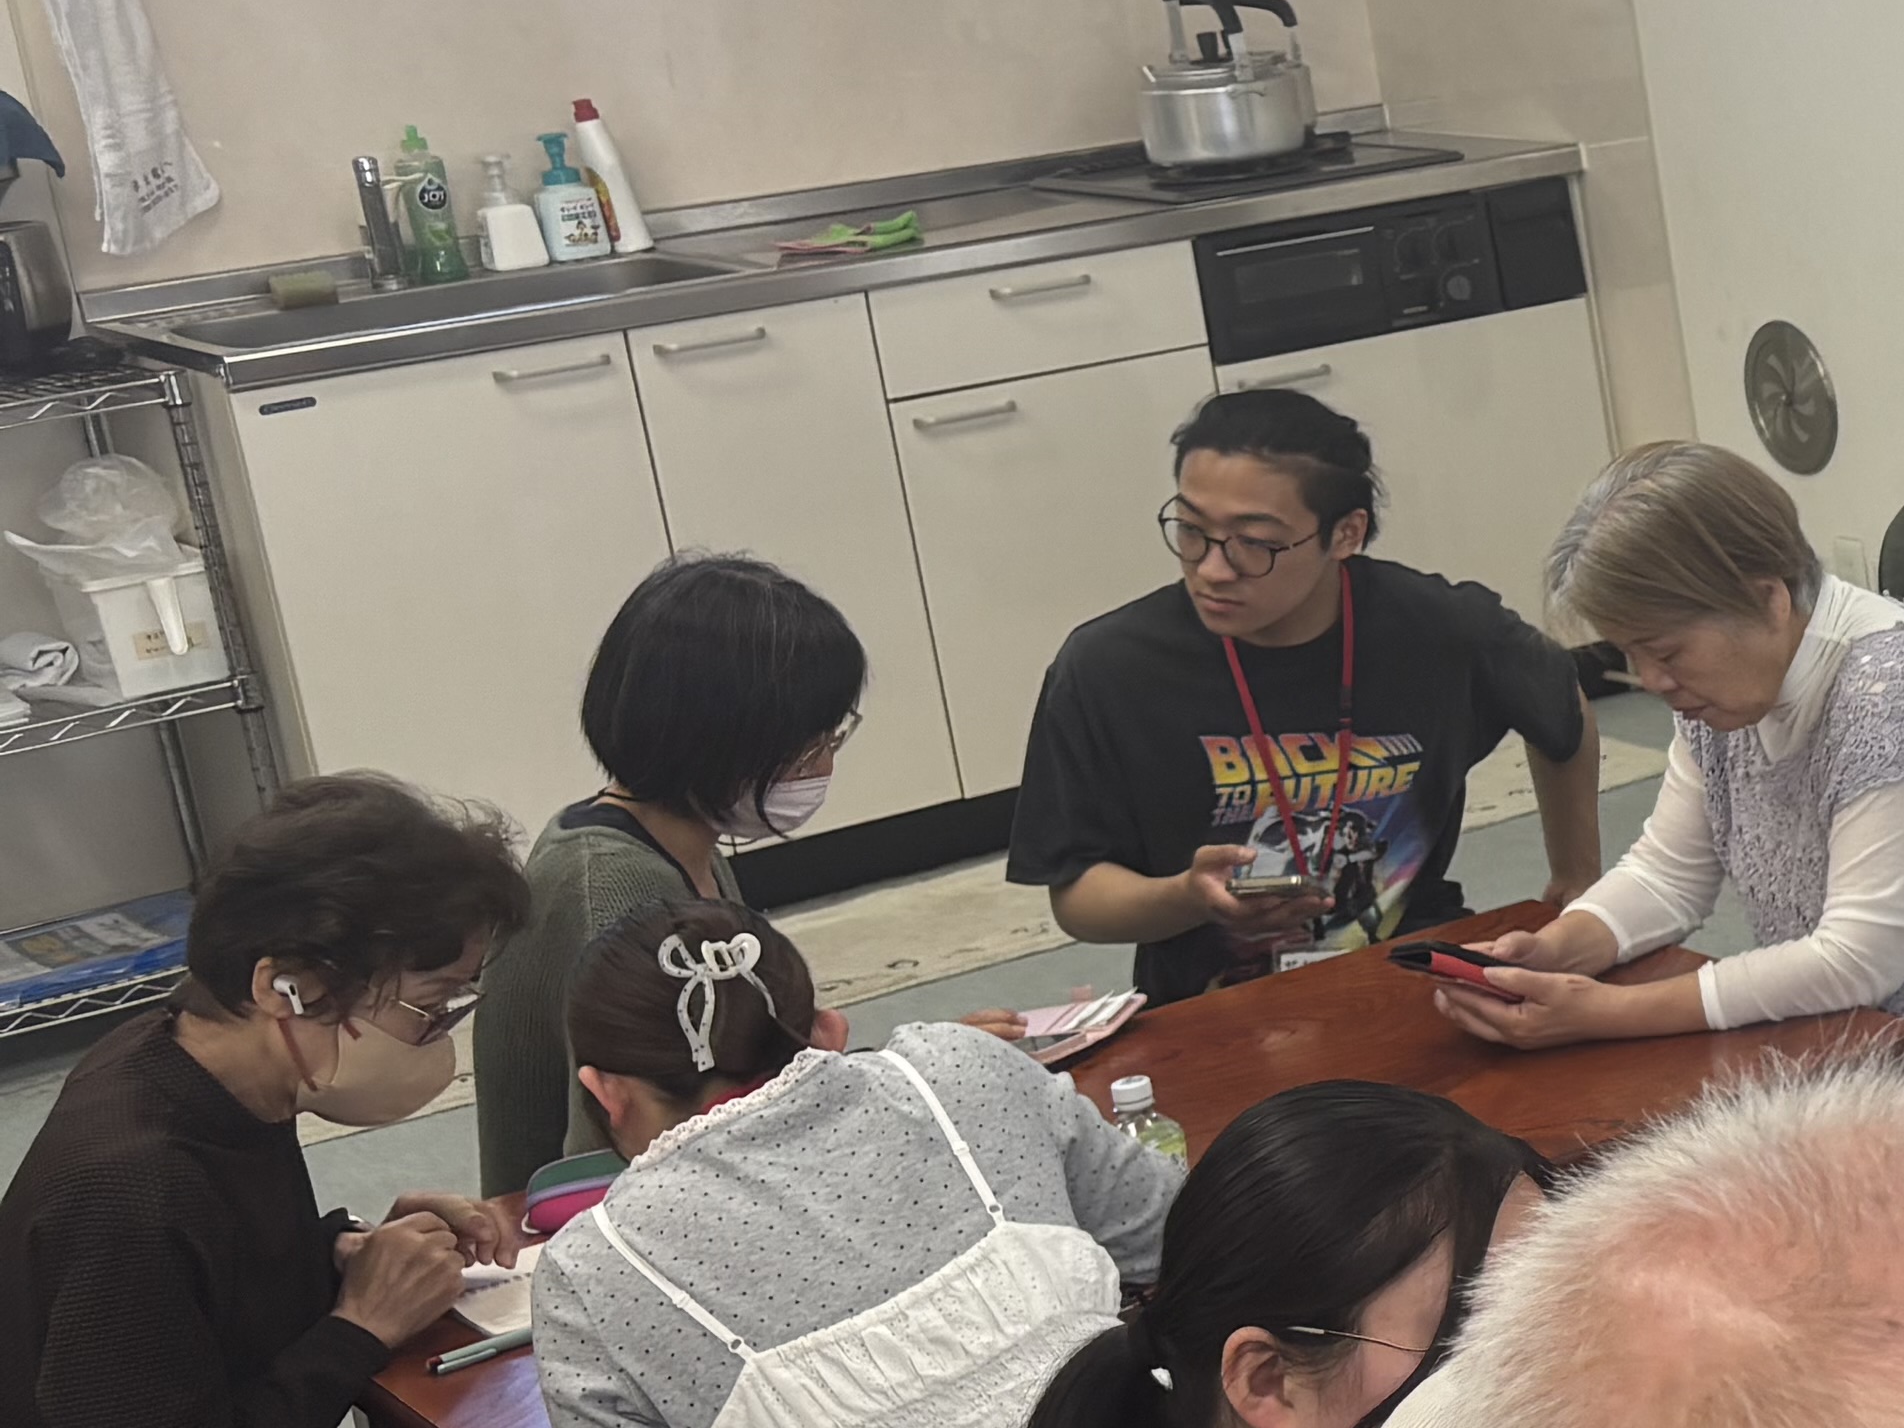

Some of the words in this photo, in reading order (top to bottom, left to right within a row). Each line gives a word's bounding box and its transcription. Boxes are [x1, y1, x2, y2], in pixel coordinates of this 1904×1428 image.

[422, 190, 445, 203] JOY
[1198, 732, 1423, 786] BACK
[1215, 784, 1252, 808] TO
[1253, 760, 1422, 819] FUTURE
